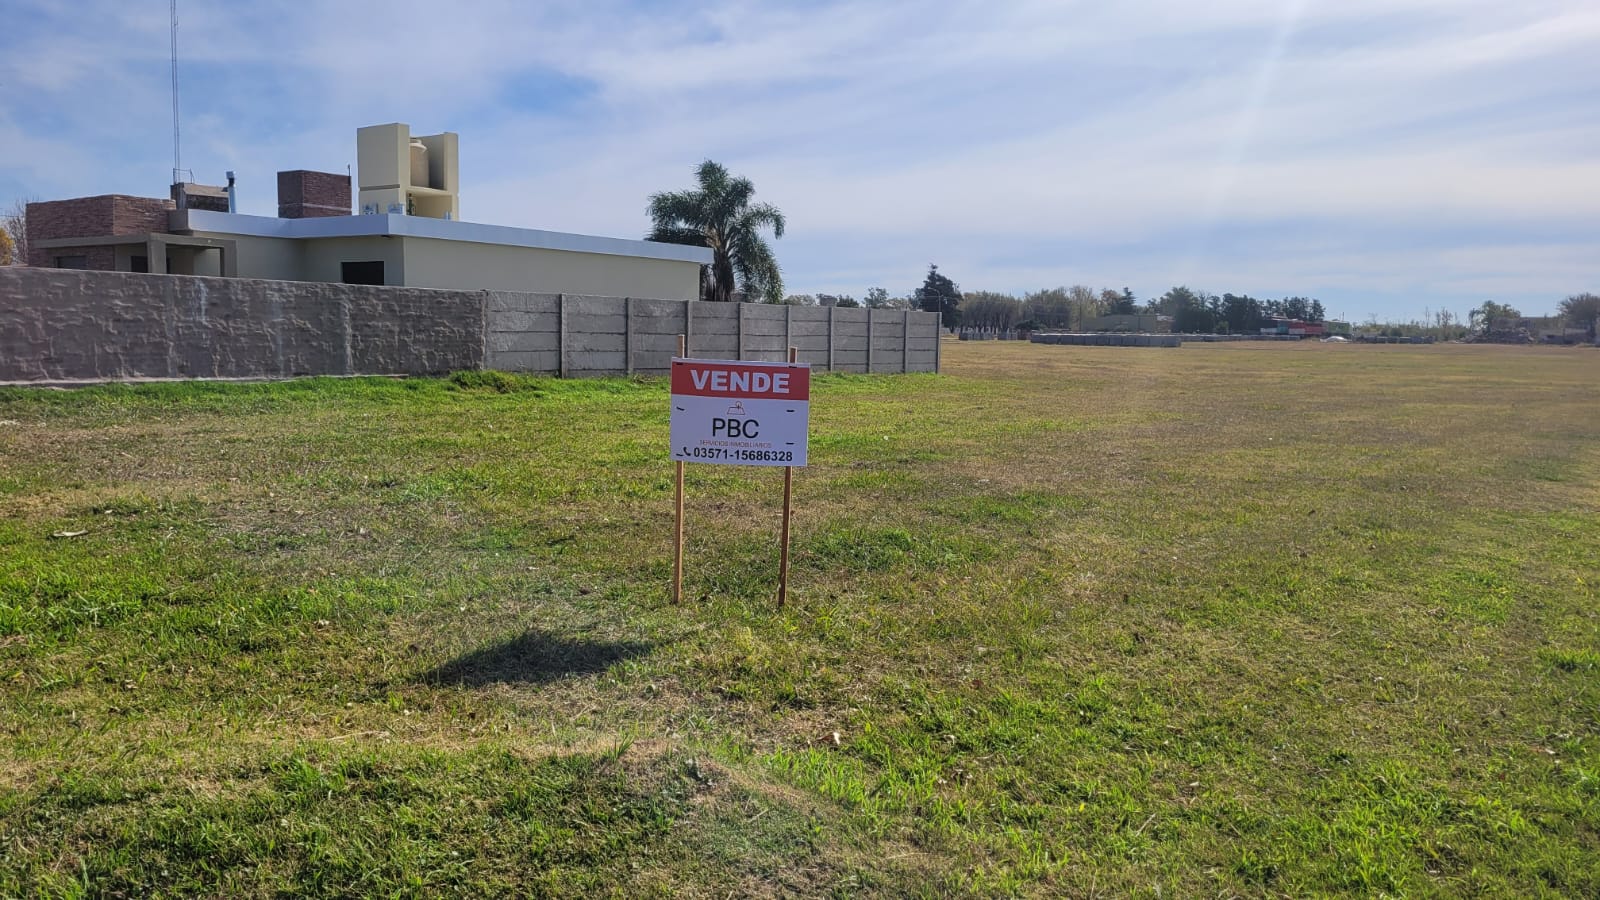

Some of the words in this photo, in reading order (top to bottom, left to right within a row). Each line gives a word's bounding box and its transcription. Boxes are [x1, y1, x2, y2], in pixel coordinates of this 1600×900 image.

[690, 369, 790, 394] VENDE
[712, 418, 760, 439] PBC
[693, 447, 793, 462] 03571-15686328
